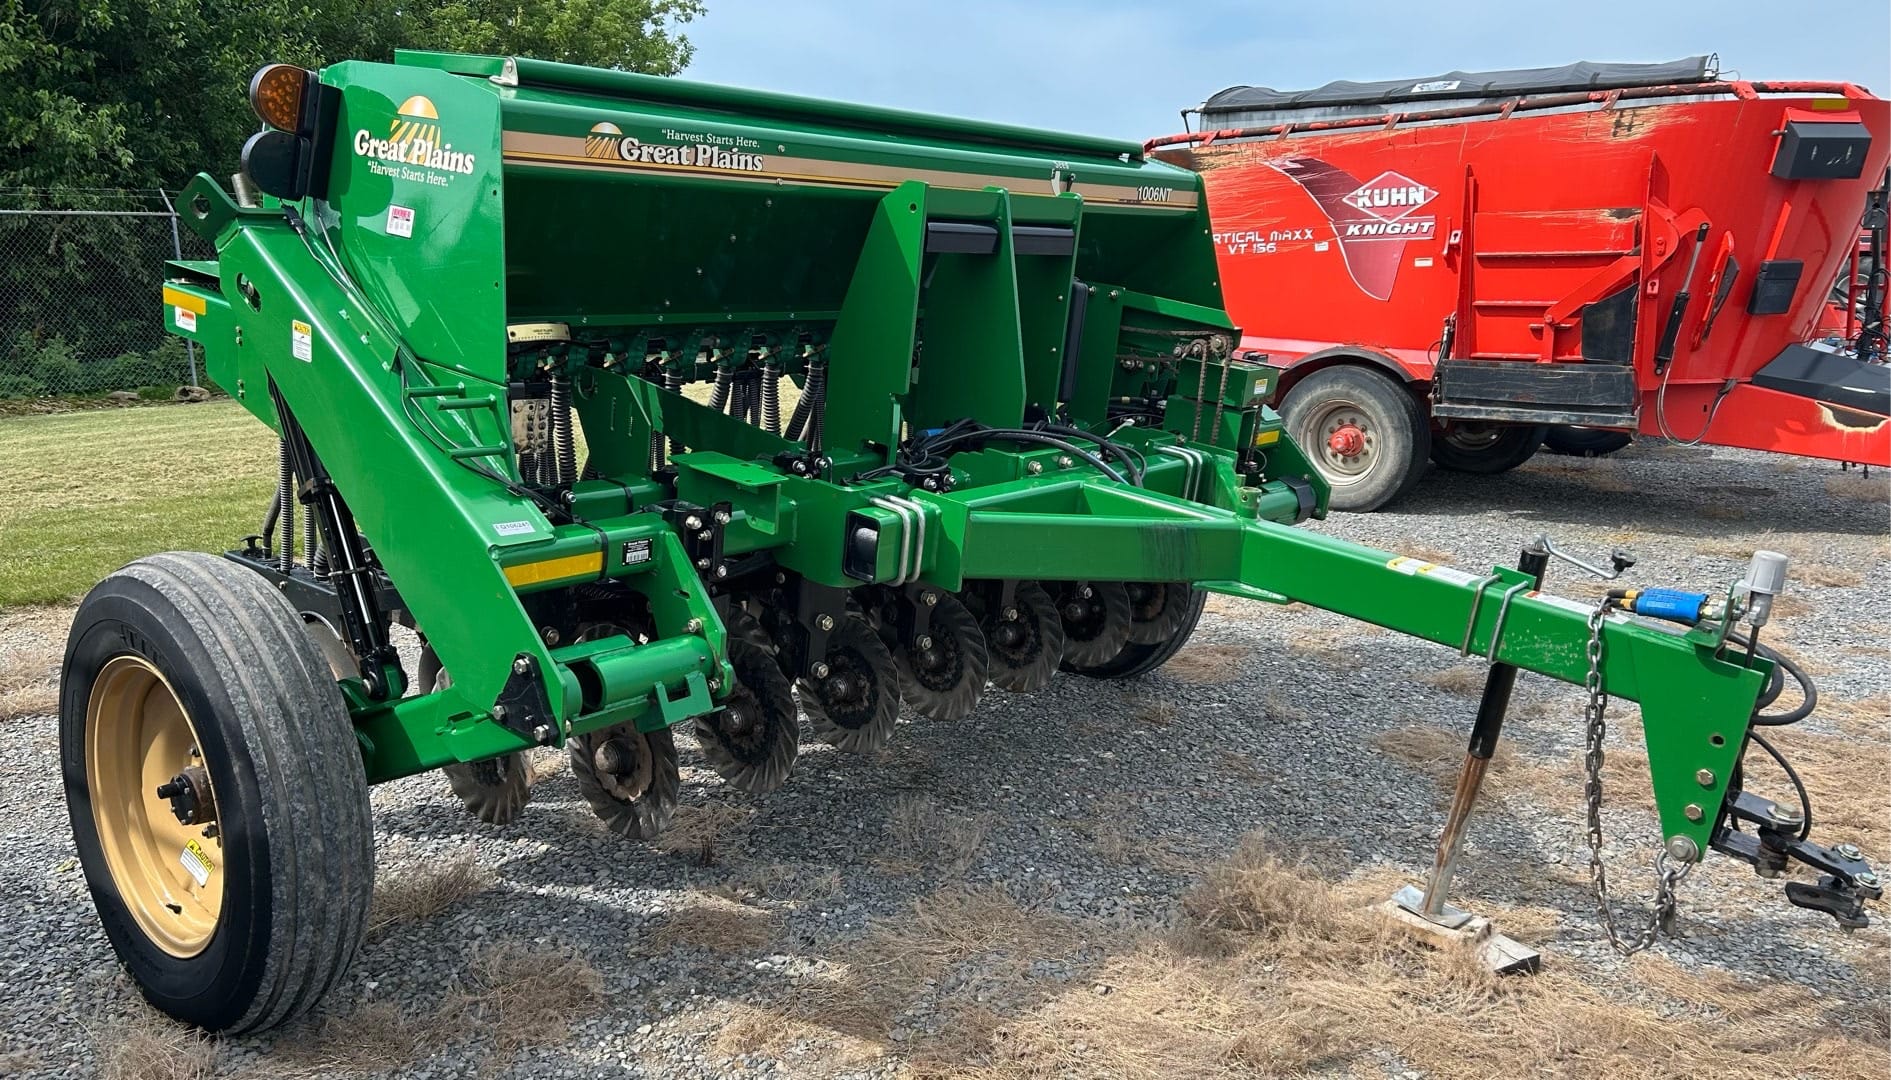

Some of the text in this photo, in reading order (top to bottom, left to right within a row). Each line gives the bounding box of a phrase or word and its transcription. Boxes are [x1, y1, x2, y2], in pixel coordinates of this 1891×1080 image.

[706, 133, 734, 146] Starts
[354, 129, 475, 175] Great Plains
[620, 137, 764, 172] Great Plains
[401, 167, 425, 183] Starts
[1137, 186, 1173, 203] 1006NT
[1357, 186, 1426, 209] KUHN
[1346, 221, 1434, 236] KNIGHT
[1212, 230, 1265, 245] RTICAL
[1228, 242, 1277, 255] VT 156
